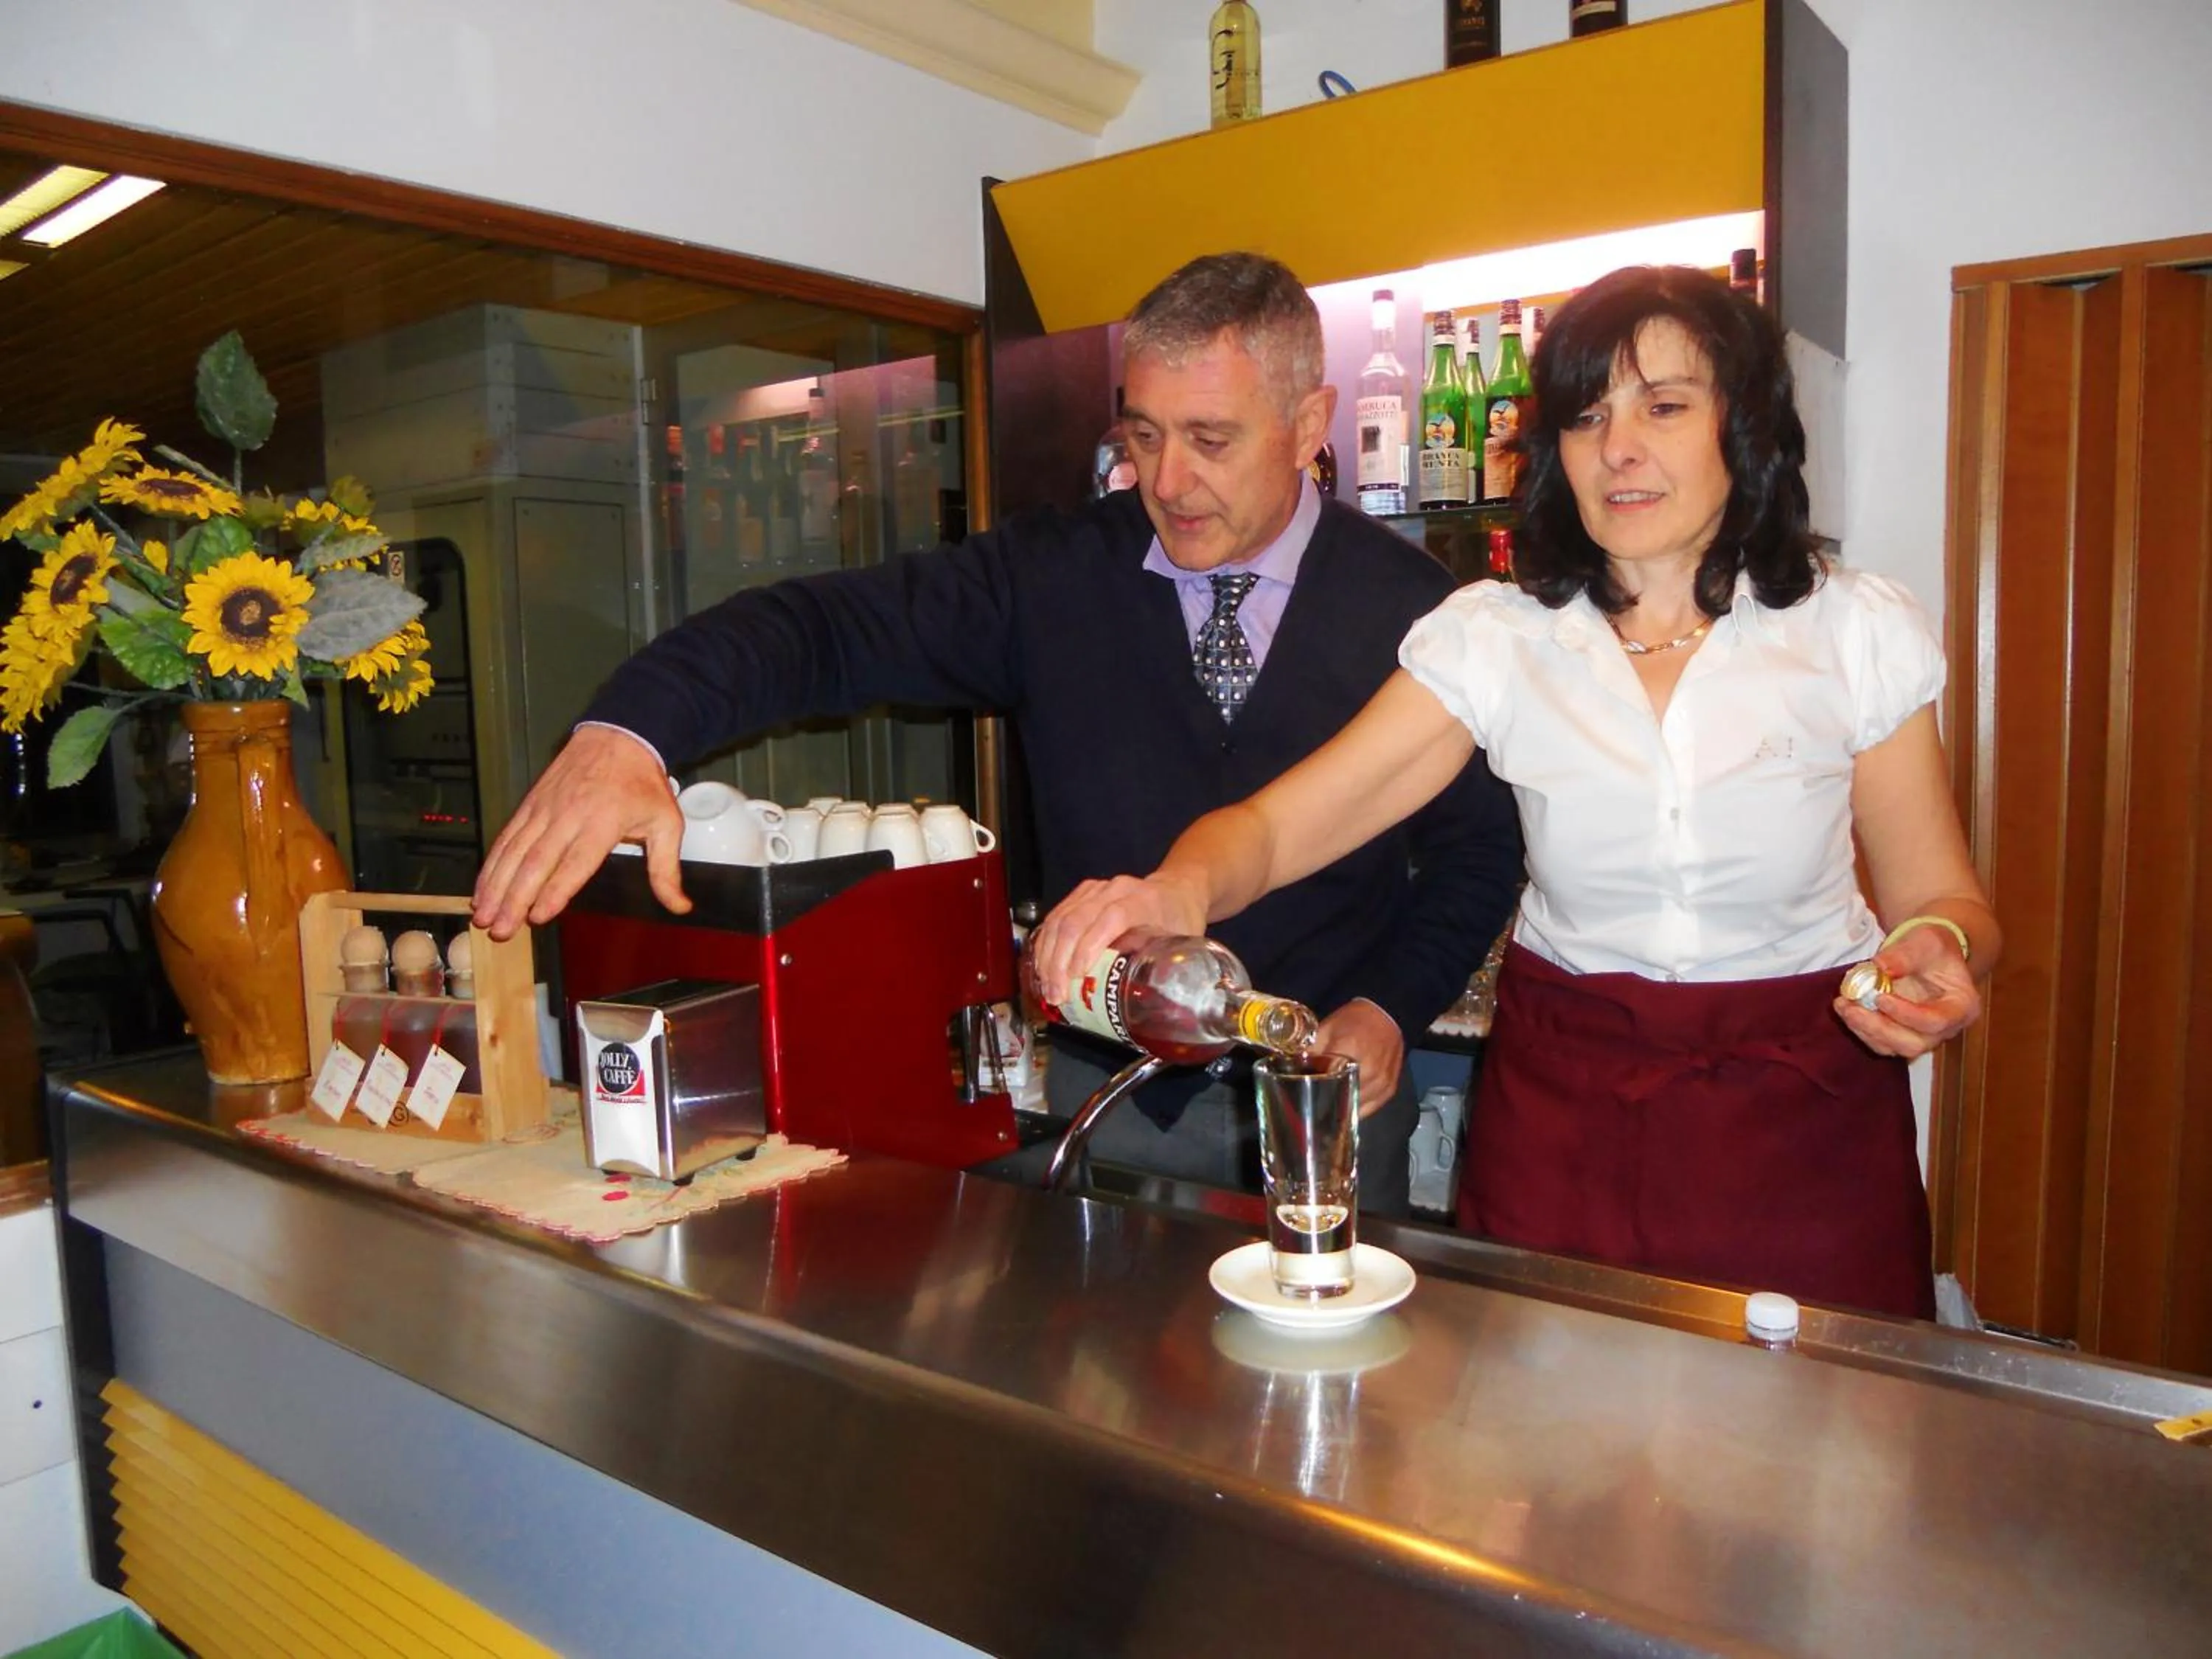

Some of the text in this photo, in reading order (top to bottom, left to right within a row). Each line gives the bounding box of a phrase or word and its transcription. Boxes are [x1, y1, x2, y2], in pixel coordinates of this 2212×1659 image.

[1422, 451, 1460, 461] BRANCA
[1422, 460, 1460, 468] MENTA
[600, 1052, 629, 1068] JOLLY
